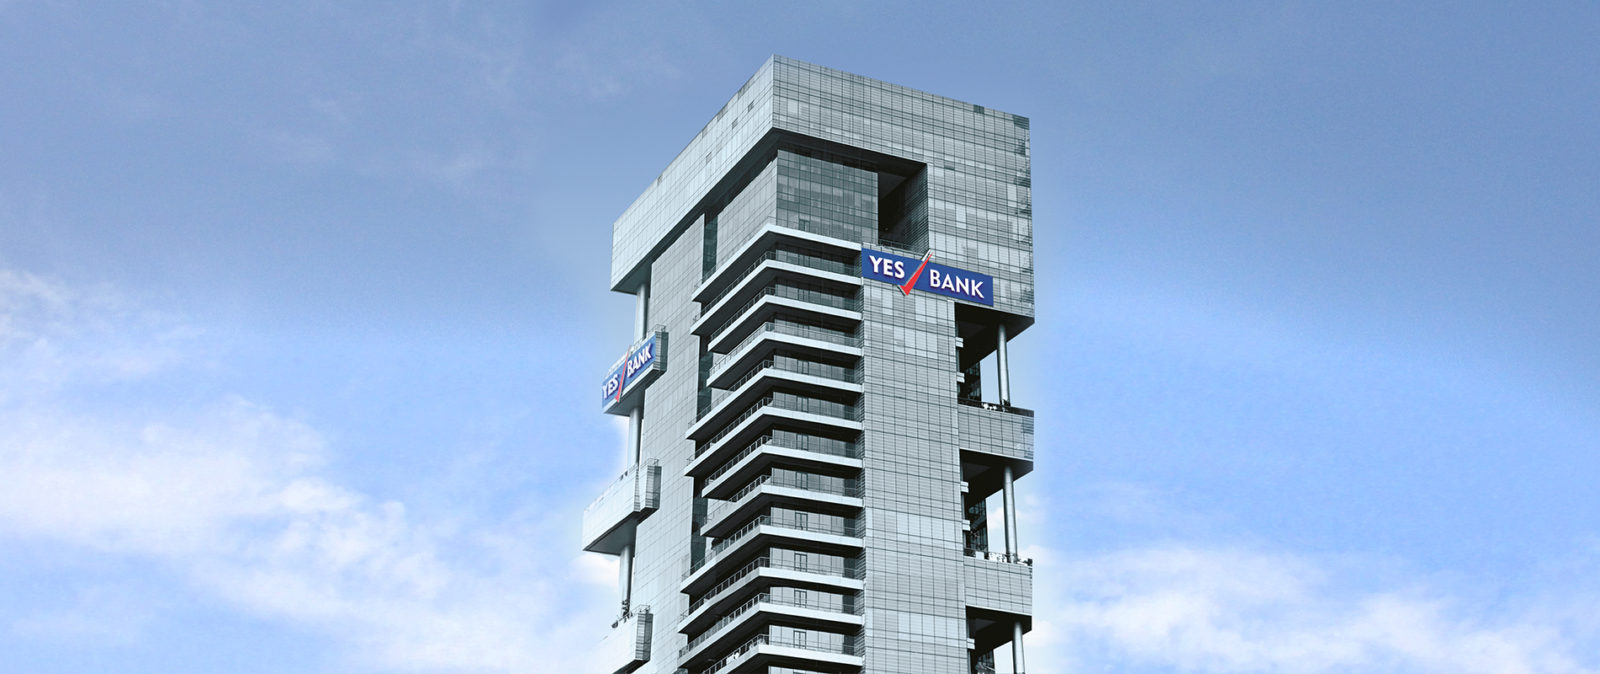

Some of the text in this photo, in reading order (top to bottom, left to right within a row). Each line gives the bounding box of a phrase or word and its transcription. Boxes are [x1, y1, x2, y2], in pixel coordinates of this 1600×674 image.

[869, 255, 984, 298] YES BANK
[602, 343, 652, 399] YES BANK
